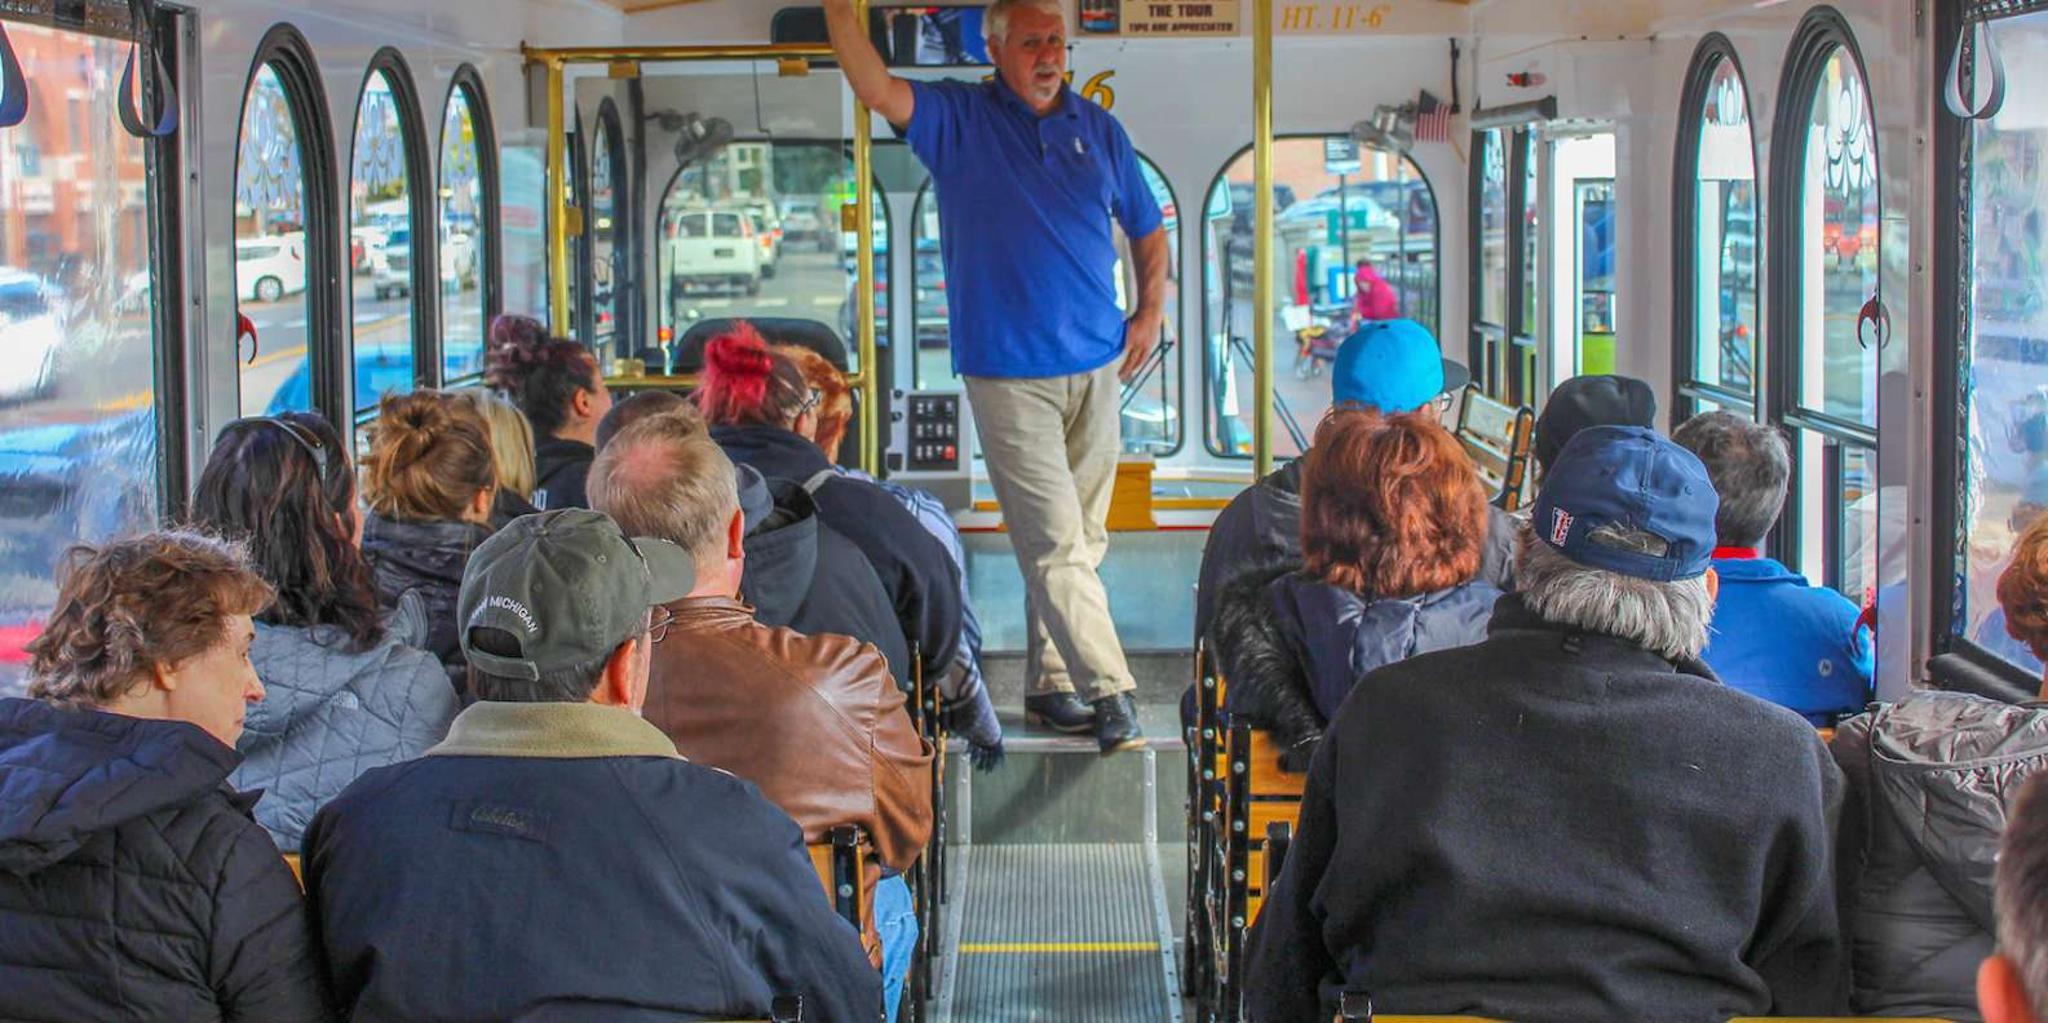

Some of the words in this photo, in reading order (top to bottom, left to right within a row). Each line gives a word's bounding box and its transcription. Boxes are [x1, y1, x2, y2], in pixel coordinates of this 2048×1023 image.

[1148, 4, 1172, 17] THE
[1178, 4, 1213, 17] TOUR
[1129, 22, 1149, 32] TIPS
[1151, 22, 1169, 32] ARE
[1171, 22, 1233, 32] APPRECIATED
[490, 595, 538, 633] MICHIGAN
